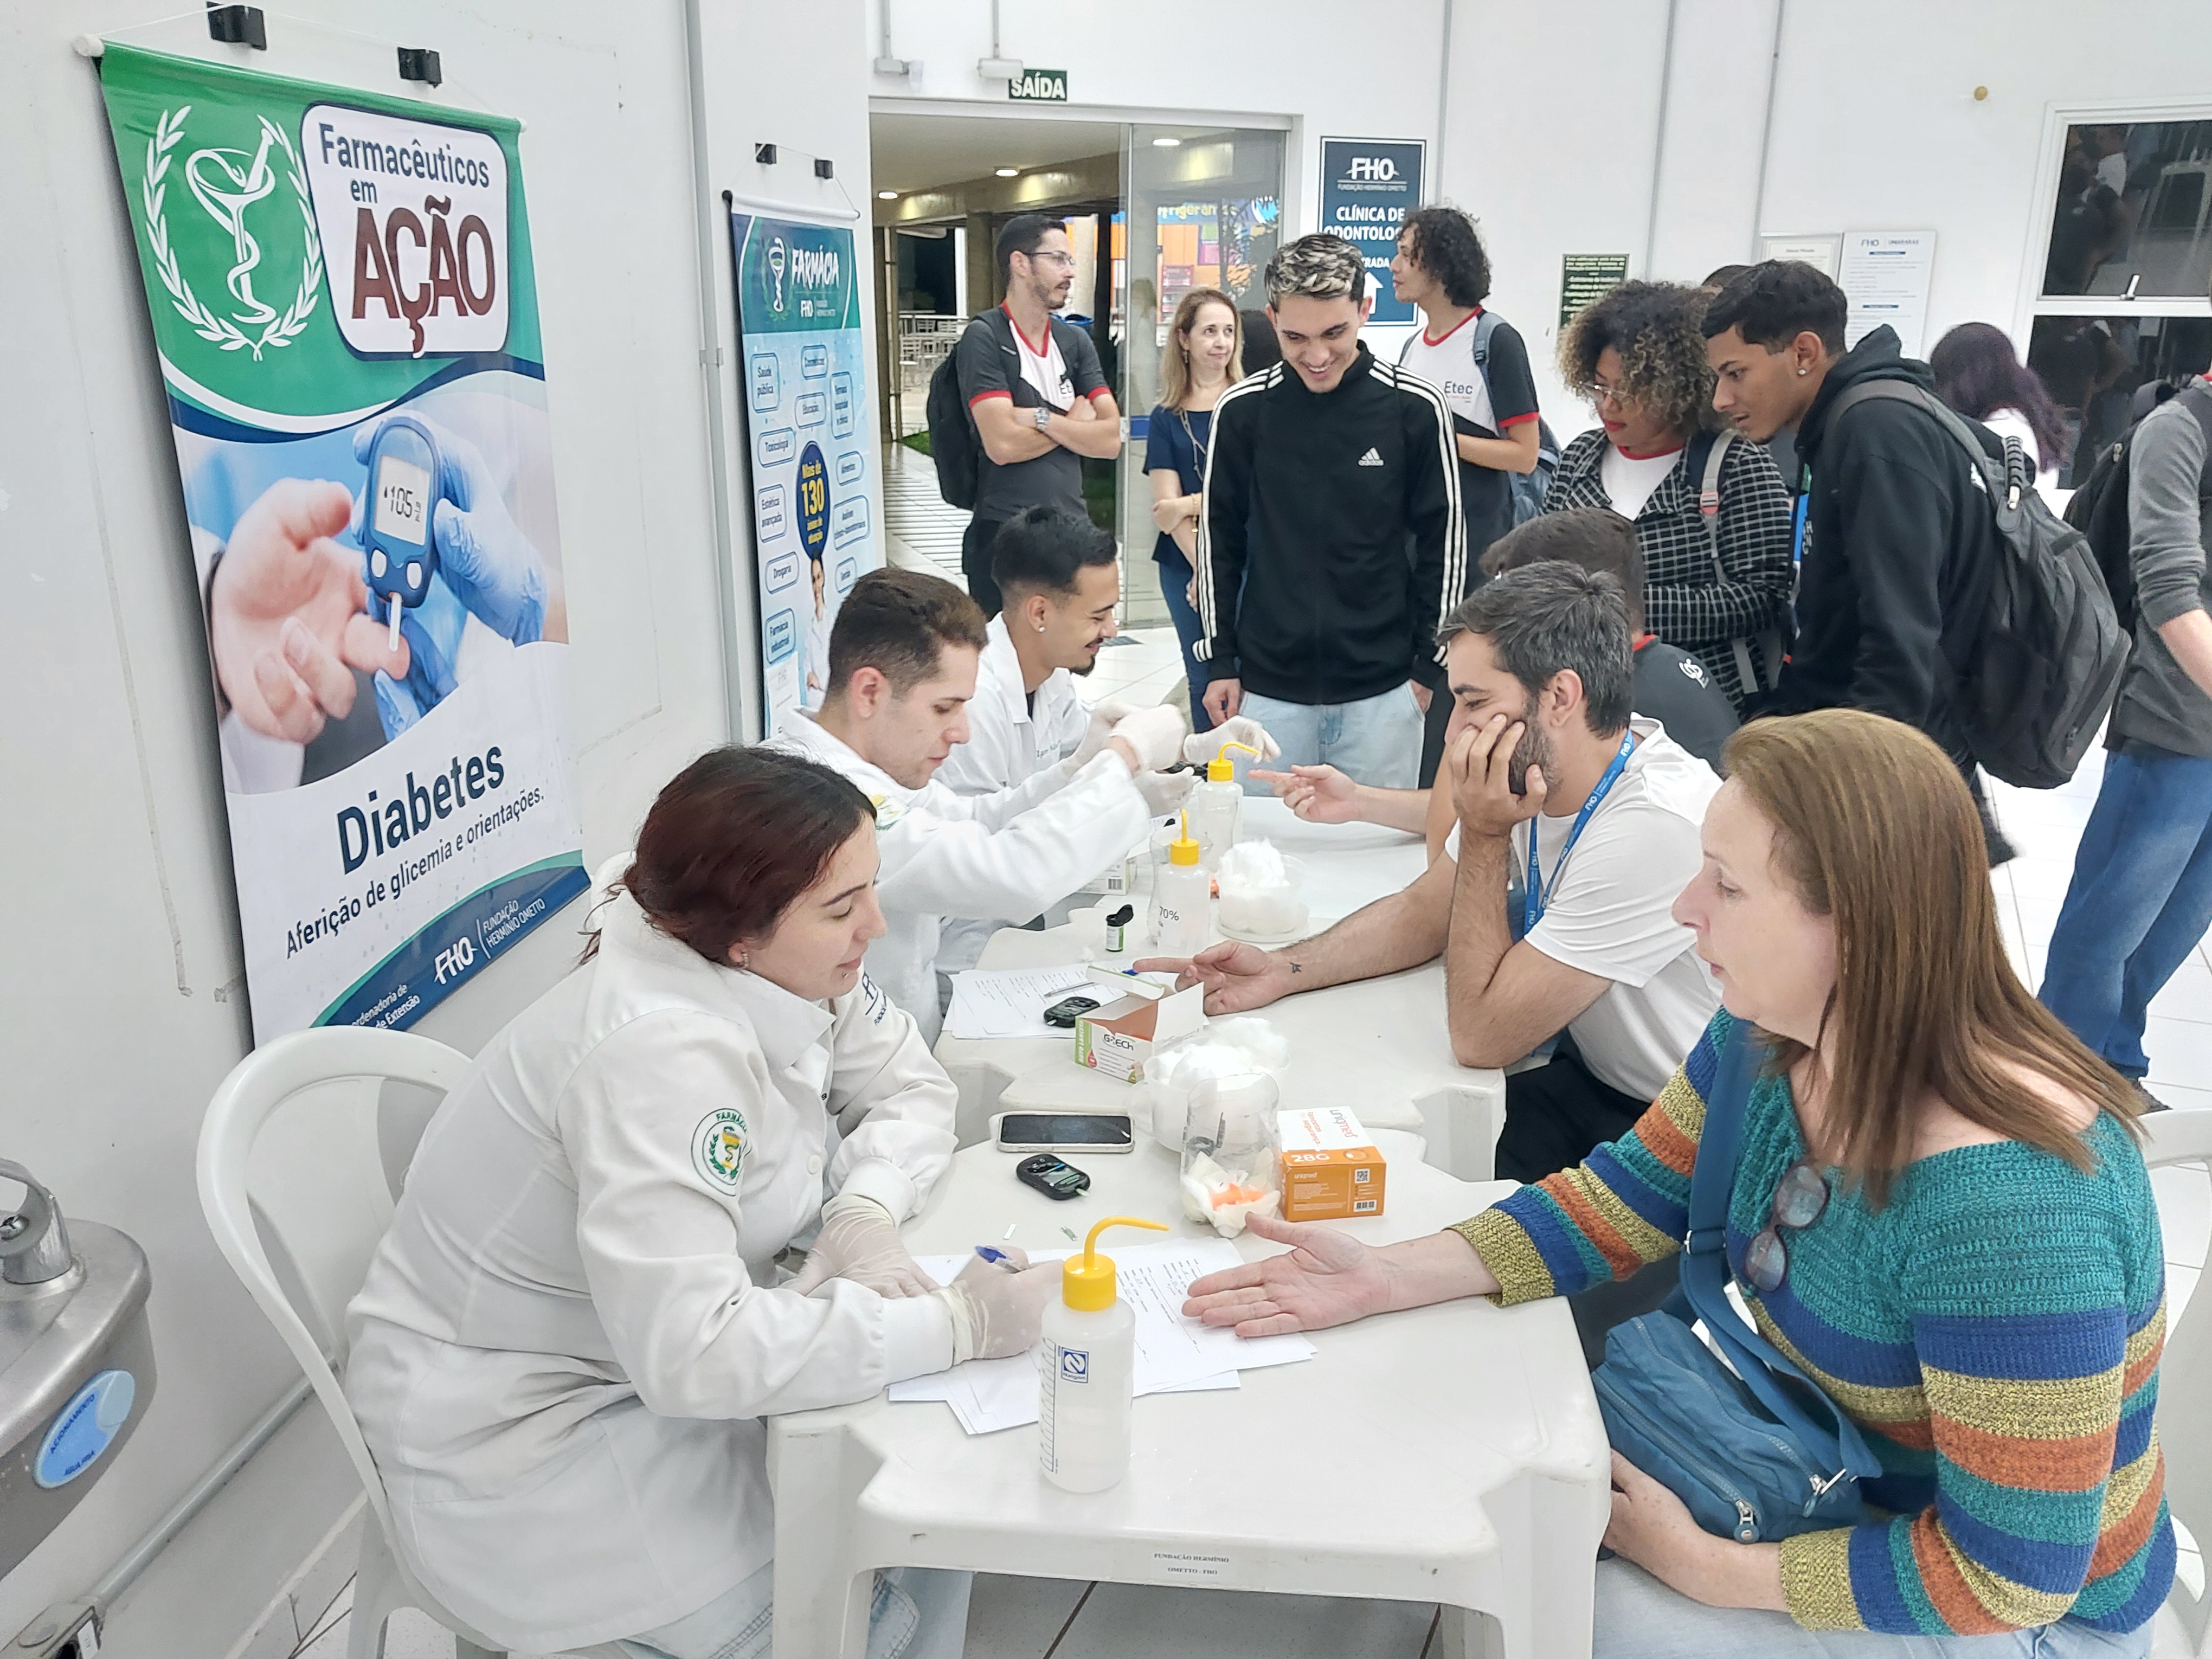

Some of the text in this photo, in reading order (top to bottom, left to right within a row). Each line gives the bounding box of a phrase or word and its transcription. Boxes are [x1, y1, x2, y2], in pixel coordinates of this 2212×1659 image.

[1011, 72, 1065, 99] SAÍDA
[319, 123, 490, 188] Farmacêuticos
[1347, 157, 1399, 181] FHO
[351, 179, 378, 203] em
[1336, 203, 1406, 222] CLÍNICA DE
[1323, 225, 1403, 241] ODONTOLO
[352, 195, 496, 354] AÇÃO
[792, 245, 839, 290] FARMÁCIA
[1444, 381, 1472, 394] Etec
[390, 486, 413, 518] 105
[801, 478, 824, 517] 130
[1620, 742, 1631, 756] FHO
[337, 746, 505, 875] Diabetes
[1585, 796, 1598, 811] FHO
[287, 788, 544, 960] Aferição de glicemia e orientações.
[483, 899, 519, 934] FUNDAÇÃO
[486, 898, 546, 949] HERMÍNIO OMETTO
[1159, 905, 1179, 921] 70%
[434, 937, 478, 985] FHO
[352, 984, 408, 1026] ordenadoria de
[376, 995, 421, 1029] de Extensão
[1291, 1153, 1330, 1162] 28G
